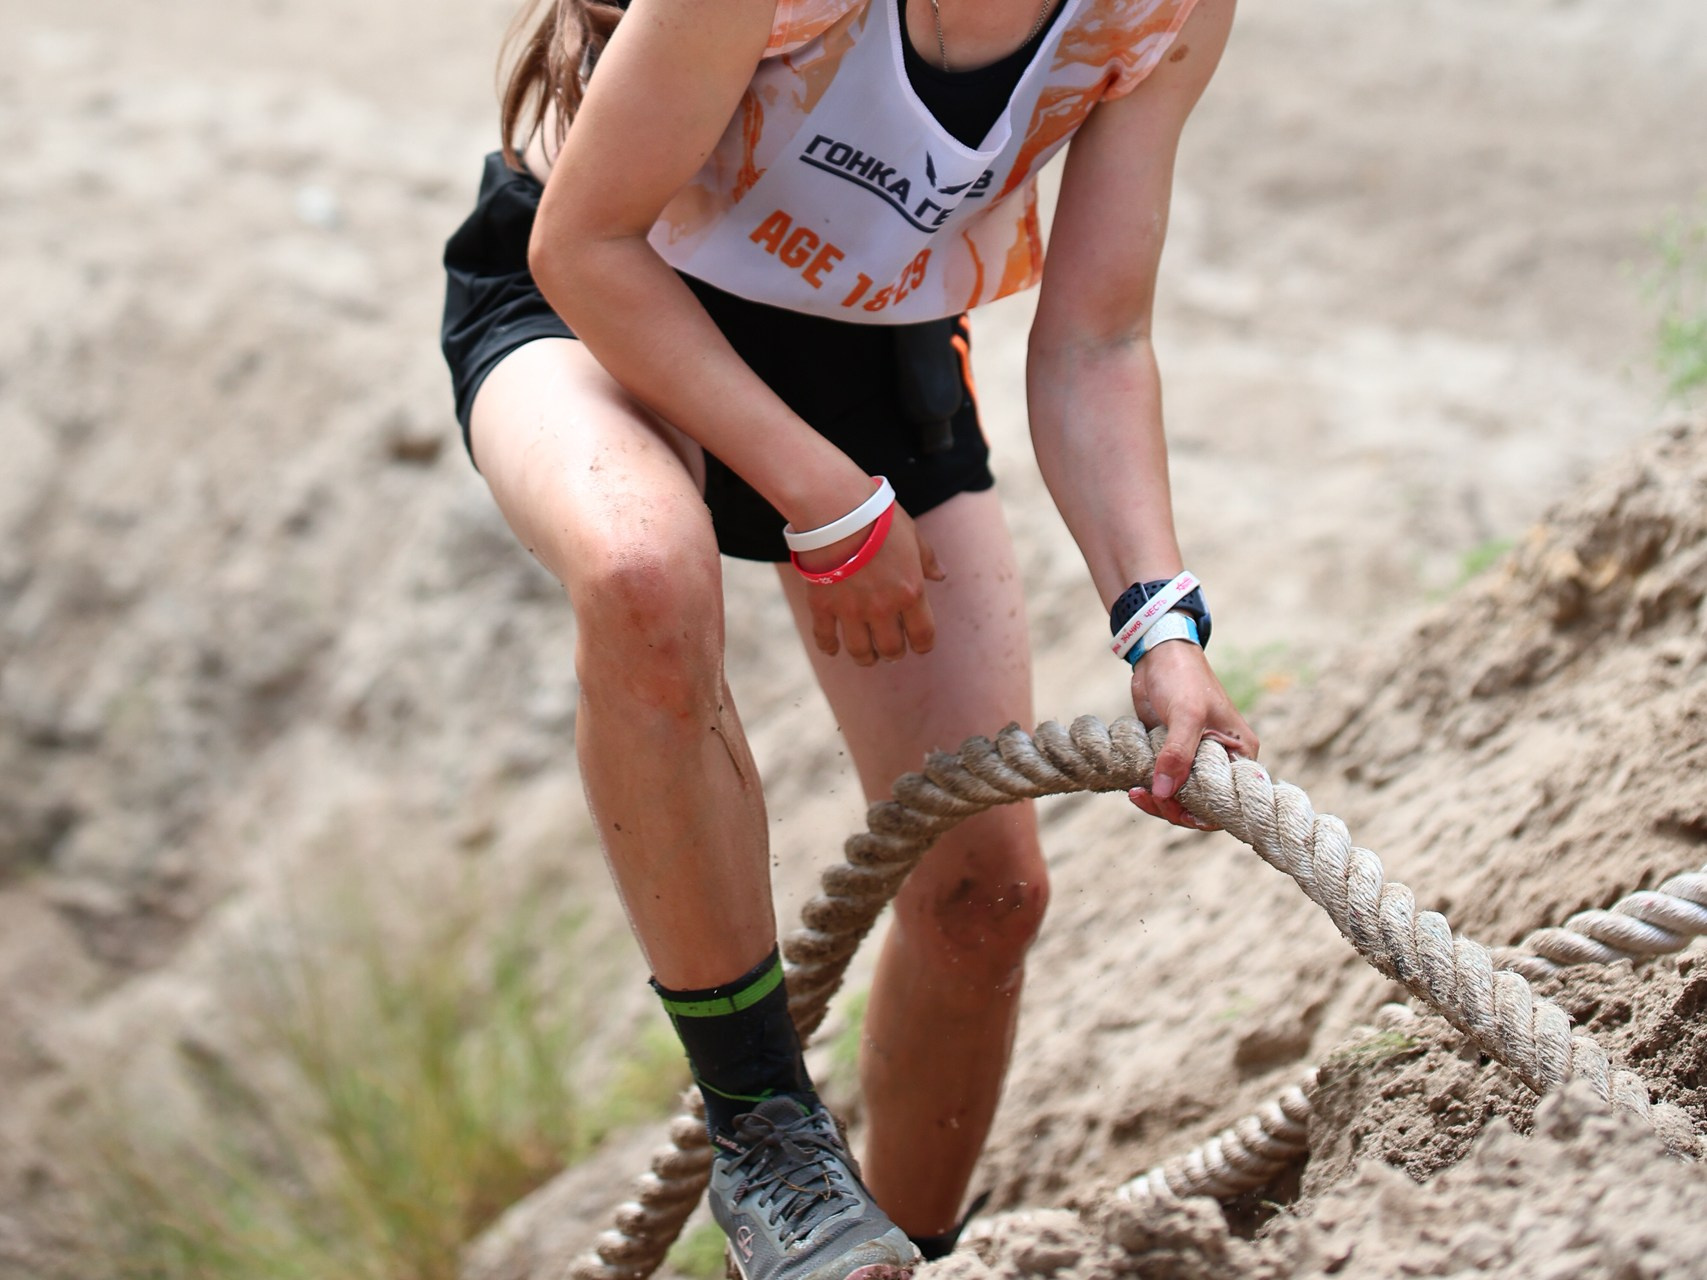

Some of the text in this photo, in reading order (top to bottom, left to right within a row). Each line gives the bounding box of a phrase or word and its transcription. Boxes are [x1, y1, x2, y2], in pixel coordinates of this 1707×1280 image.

[804, 134, 995, 226] ГОНКА ГЕВ
[748, 209, 845, 290] AGE
[1144, 599, 1168, 618] ЧЕСТЬ
